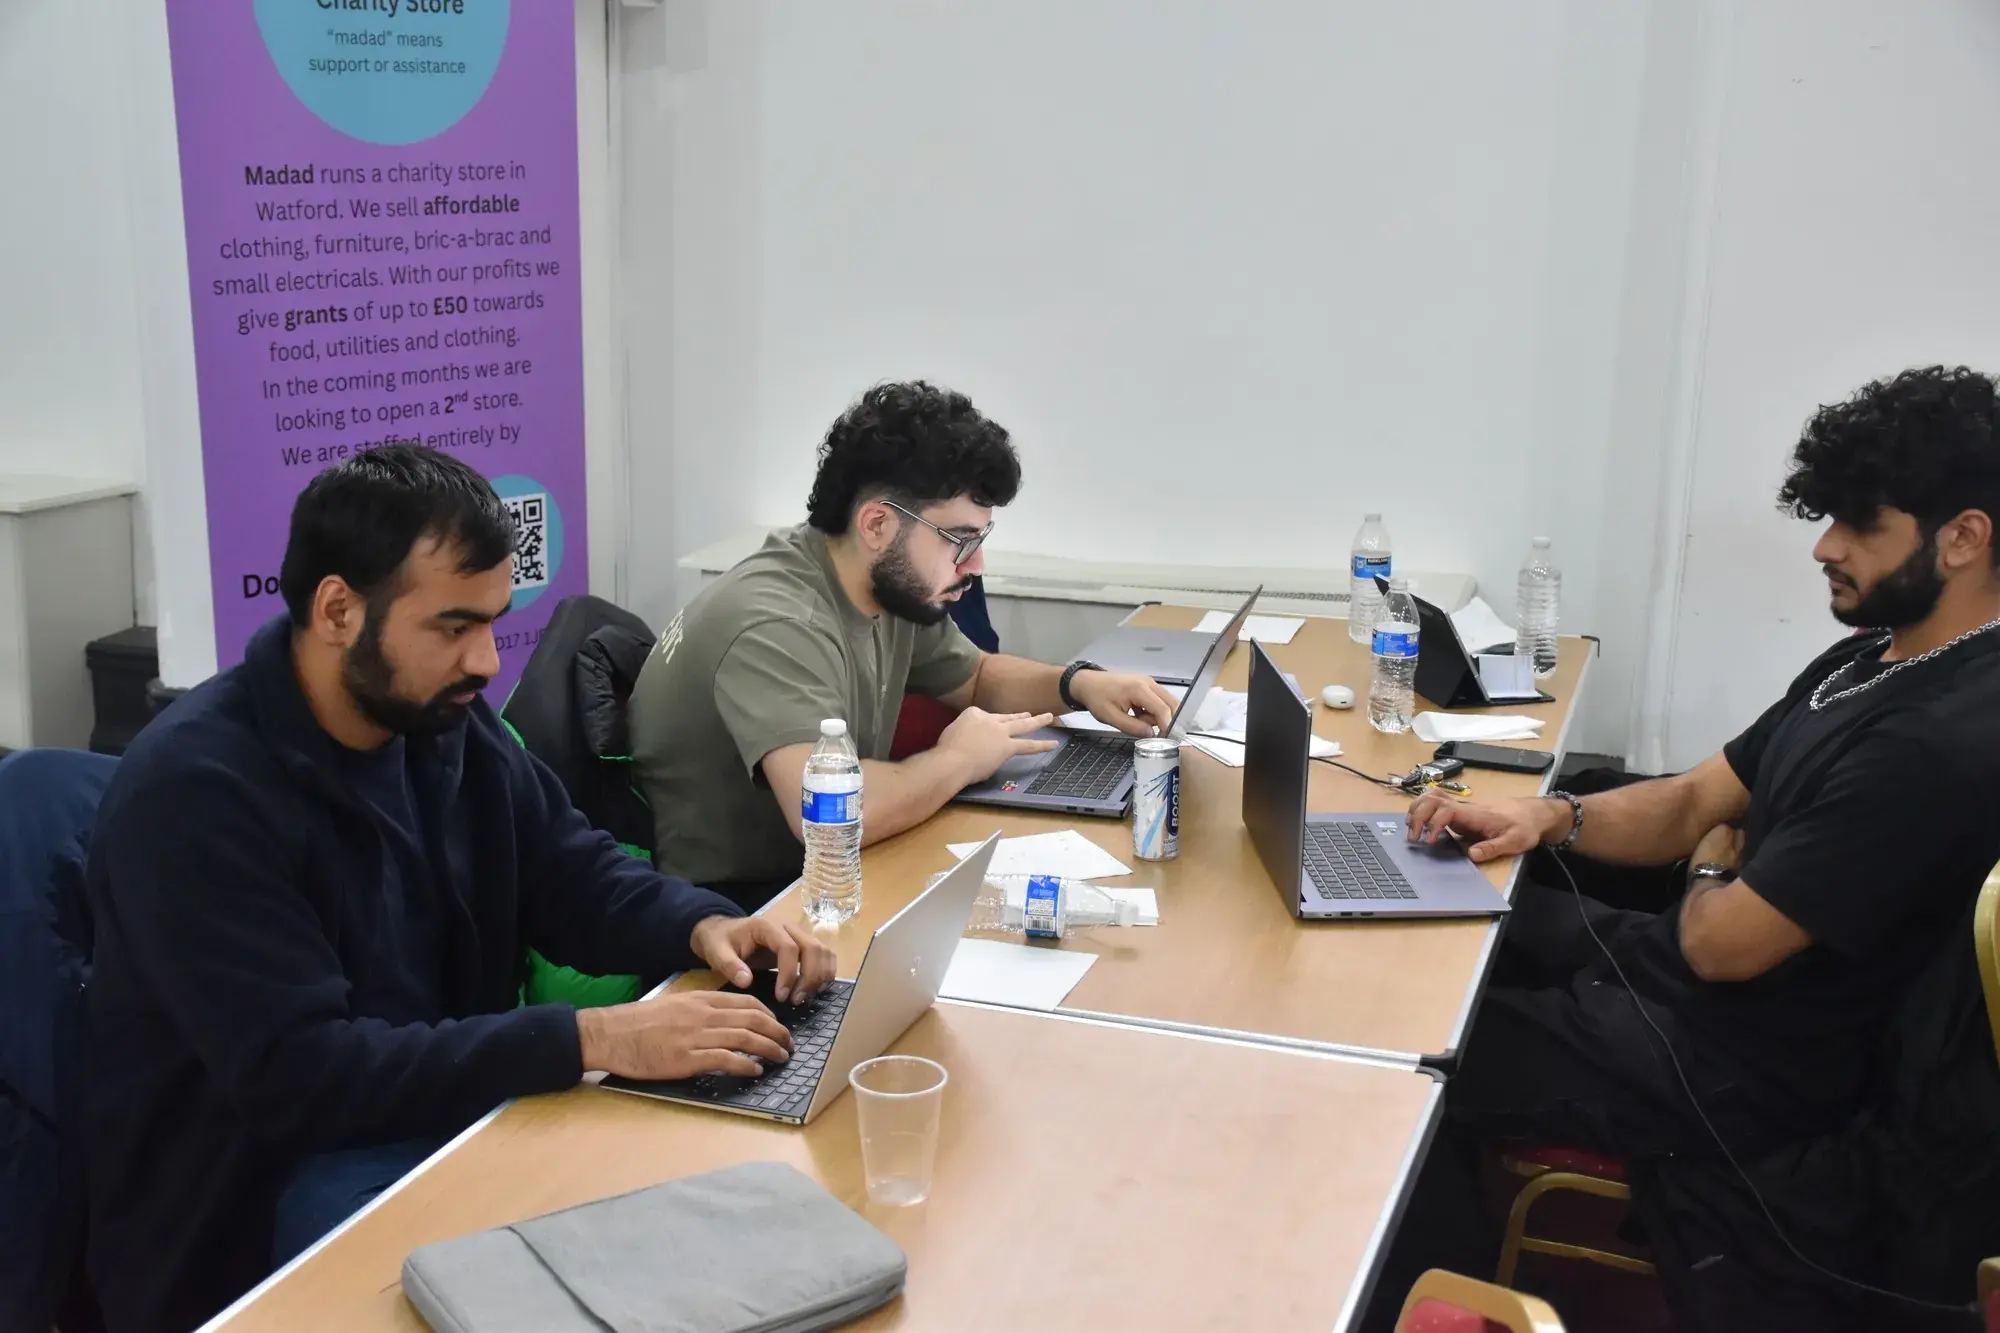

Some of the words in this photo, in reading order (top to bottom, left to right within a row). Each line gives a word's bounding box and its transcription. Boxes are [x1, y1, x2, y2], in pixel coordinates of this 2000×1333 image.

[397, 35, 443, 47] means
[309, 58, 370, 76] support
[374, 60, 389, 72] or
[392, 60, 465, 74] assistance
[245, 164, 314, 185] Madad
[321, 168, 365, 184] runs
[372, 168, 382, 183] a
[388, 162, 453, 187] charity
[458, 164, 506, 181] store
[510, 160, 525, 179] in
[255, 199, 343, 221] Watford.
[349, 199, 380, 218] We
[386, 196, 419, 217] sell
[424, 194, 519, 215] affordable
[220, 237, 309, 261] clothing,
[314, 233, 409, 254] furniture,
[415, 228, 515, 250] bric-a-brac
[520, 225, 551, 245] and
[213, 273, 270, 296] small
[276, 268, 383, 292] electricals.
[389, 264, 431, 285] With
[437, 266, 467, 282] our
[473, 259, 531, 284] profits
[536, 261, 559, 276] we
[238, 309, 279, 335] give
[285, 306, 348, 332] grants
[354, 301, 374, 321] of
[380, 304, 404, 323] up
[409, 301, 428, 317] to
[434, 296, 467, 315] £50
[473, 290, 544, 312] towards
[269, 339, 320, 362] food,
[327, 335, 399, 357] utilities
[405, 330, 438, 352] and
[444, 326, 520, 348] clothing.
[263, 380, 280, 399] In
[286, 376, 318, 396] the
[324, 370, 397, 393] coming
[401, 363, 470, 385] months
[475, 363, 499, 378] we
[504, 360, 531, 375] are
[276, 408, 346, 432] looking
[351, 407, 371, 423] to
[377, 403, 424, 425] open
[430, 401, 440, 415] a
[473, 393, 523, 410] store.
[282, 447, 311, 466] We
[317, 443, 349, 462] are
[427, 425, 494, 449] entirely
[500, 424, 521, 444] by
[1171, 775, 1180, 827] BOOST
